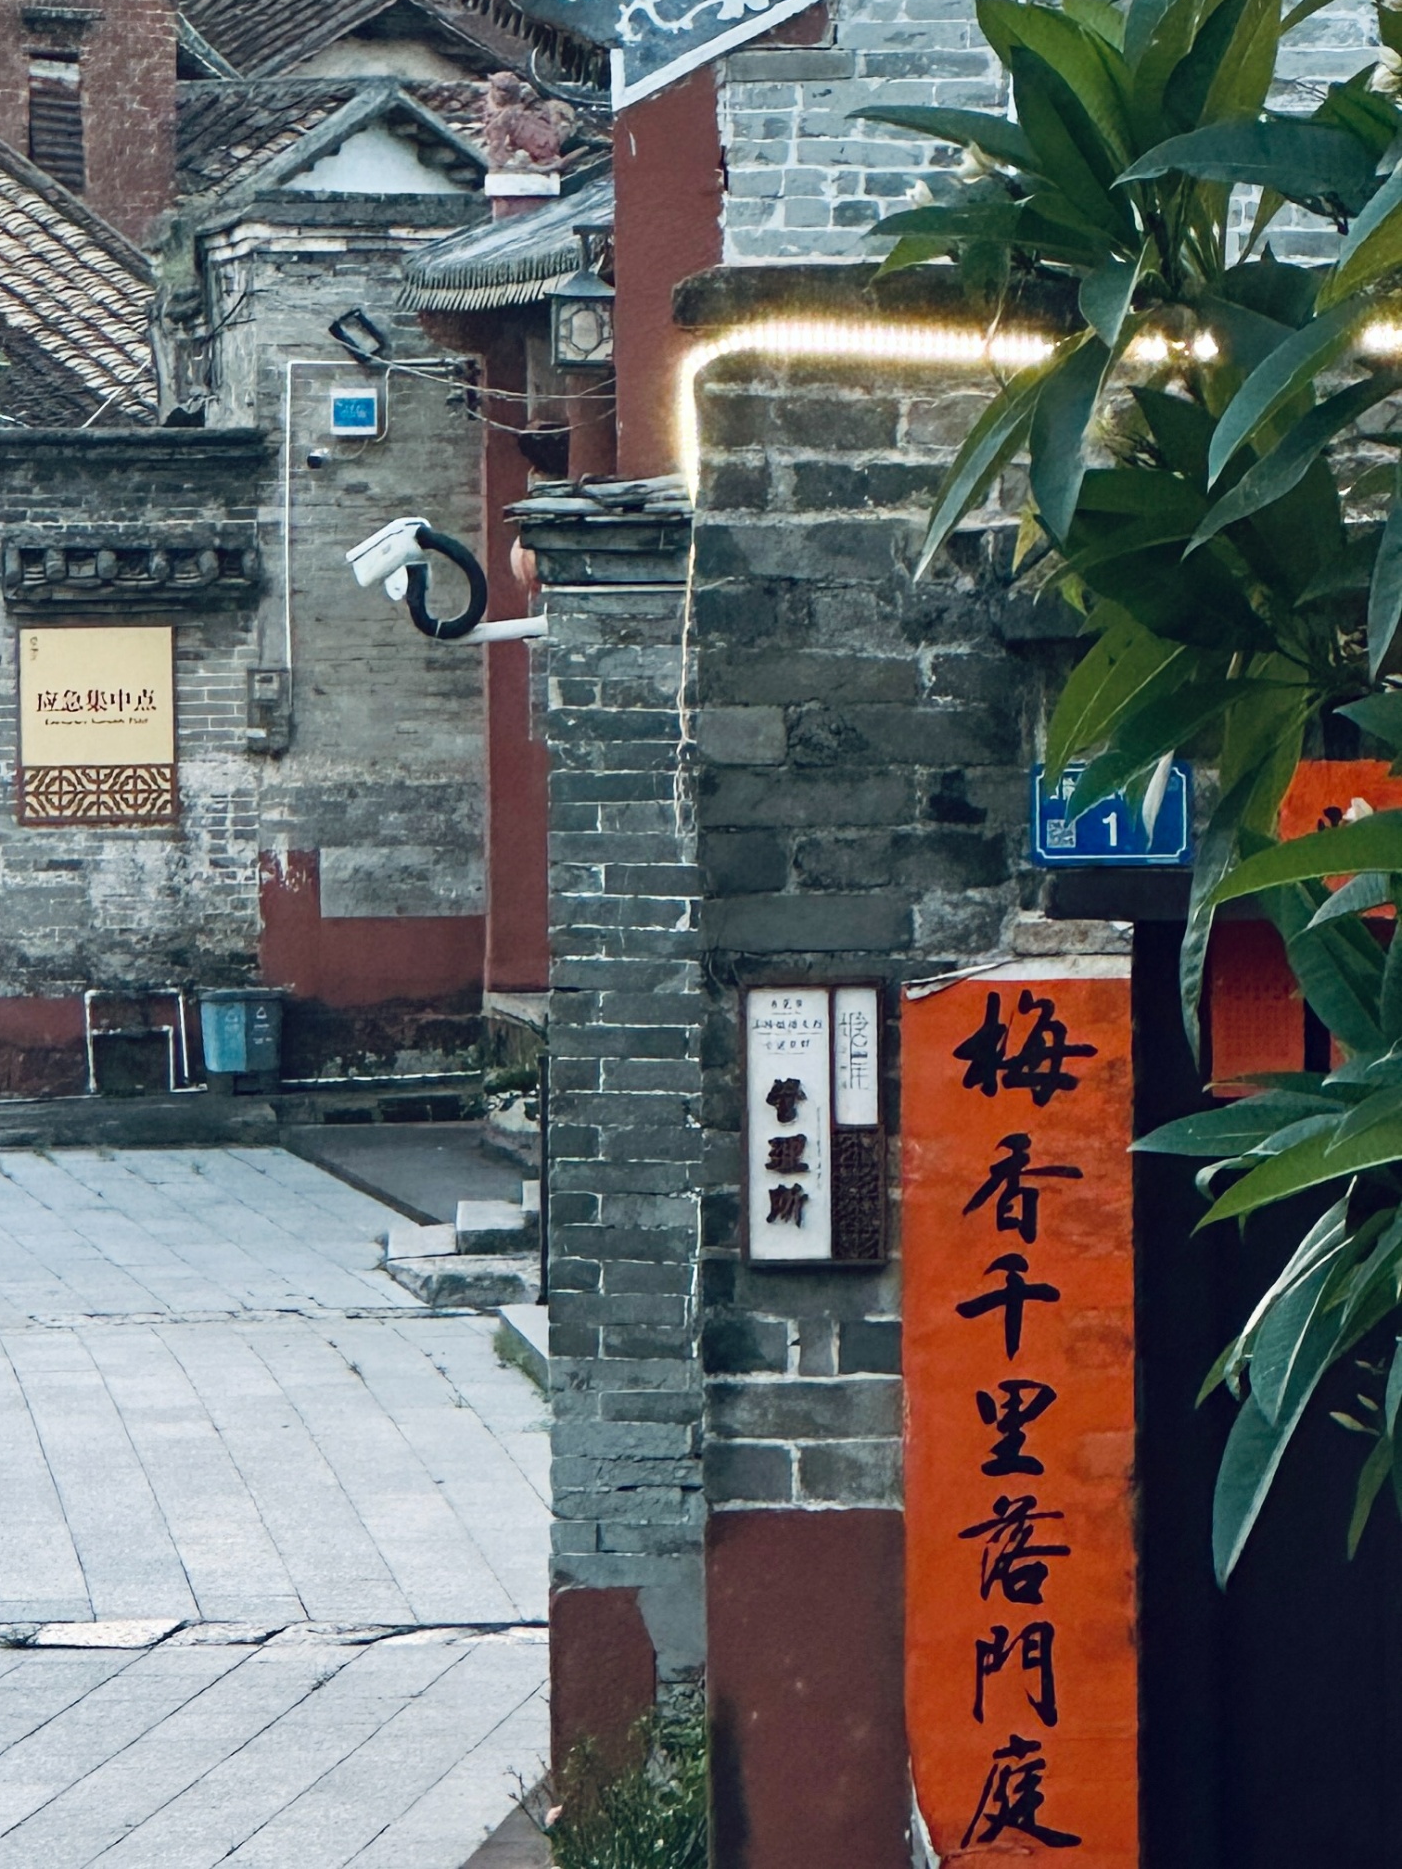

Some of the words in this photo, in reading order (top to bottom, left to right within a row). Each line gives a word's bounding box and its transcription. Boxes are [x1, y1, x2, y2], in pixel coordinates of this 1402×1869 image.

[36, 688, 157, 713] 应急集中点
[1102, 811, 1118, 847] 1
[953, 989, 1098, 1849] 梅香千里落門庭
